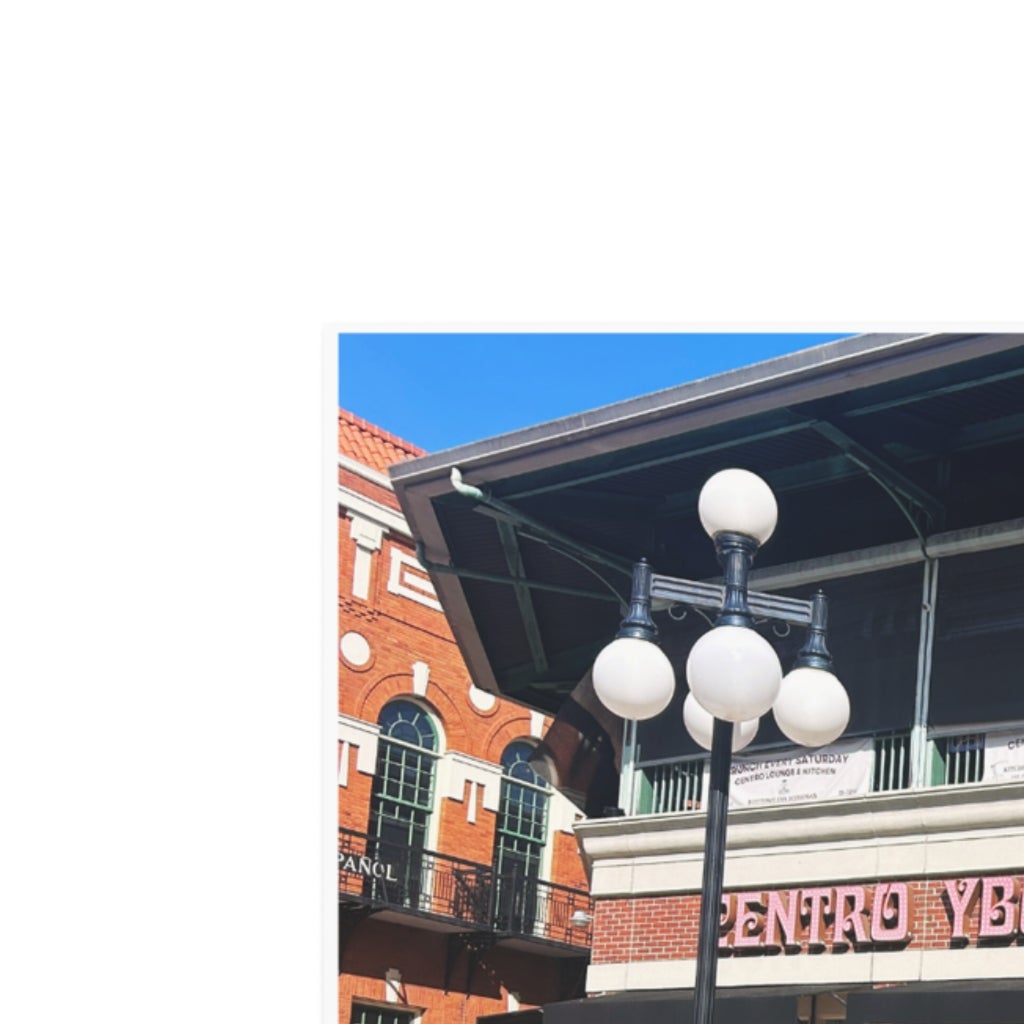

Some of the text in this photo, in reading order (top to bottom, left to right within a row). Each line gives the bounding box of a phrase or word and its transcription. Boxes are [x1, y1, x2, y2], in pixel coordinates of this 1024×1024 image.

[730, 762, 762, 776] RUNCH
[795, 754, 849, 765] SATURDAY
[734, 771, 765, 785] CENTRO
[766, 768, 795, 780] LOUNGE
[802, 766, 836, 776] KITCHEN
